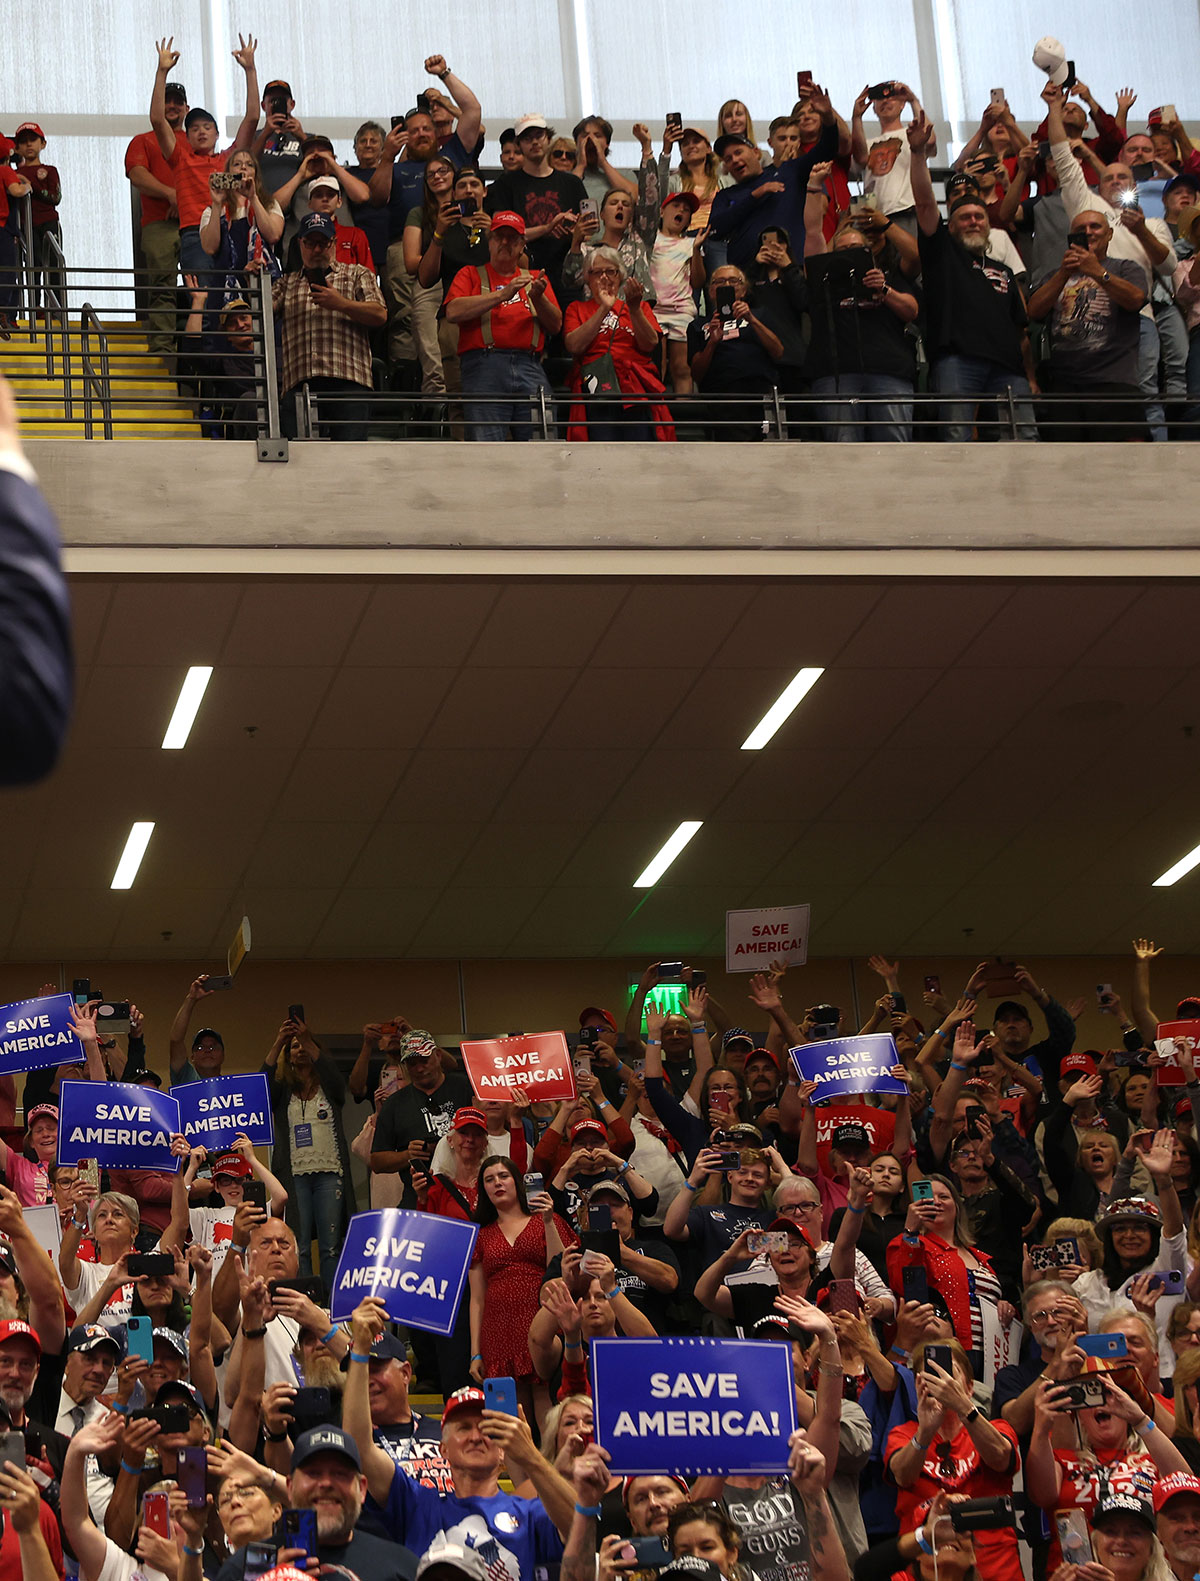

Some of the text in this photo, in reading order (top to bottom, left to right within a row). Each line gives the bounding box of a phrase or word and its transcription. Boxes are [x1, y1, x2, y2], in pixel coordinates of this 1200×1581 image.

[751, 923, 789, 937] SAVE
[734, 938, 802, 956] AMERICA!
[5, 1014, 51, 1034] SAVE
[493, 1052, 541, 1069] SAVE
[825, 1051, 873, 1066] SAVE
[480, 1068, 564, 1087] AMERICA!
[198, 1093, 244, 1112] SAVE
[95, 1104, 152, 1122] SAVE
[184, 1112, 265, 1137] AMERICA!
[817, 1120, 875, 1136] ULTRA
[815, 1132, 875, 1146] MA
[215, 1156, 241, 1169] TRUMP
[363, 1237, 426, 1263] SAVE
[339, 1266, 450, 1301] AMERICA!
[650, 1372, 740, 1399] SAVE
[612, 1410, 780, 1437] AMERICA!
[310, 1432, 345, 1449] FJB
[1159, 1470, 1199, 1486] ALASKA
[1160, 1479, 1200, 1493] TRUMP
[728, 1493, 795, 1527] GOD
[747, 1526, 801, 1554] GUNS
[774, 1550, 787, 1565] &
